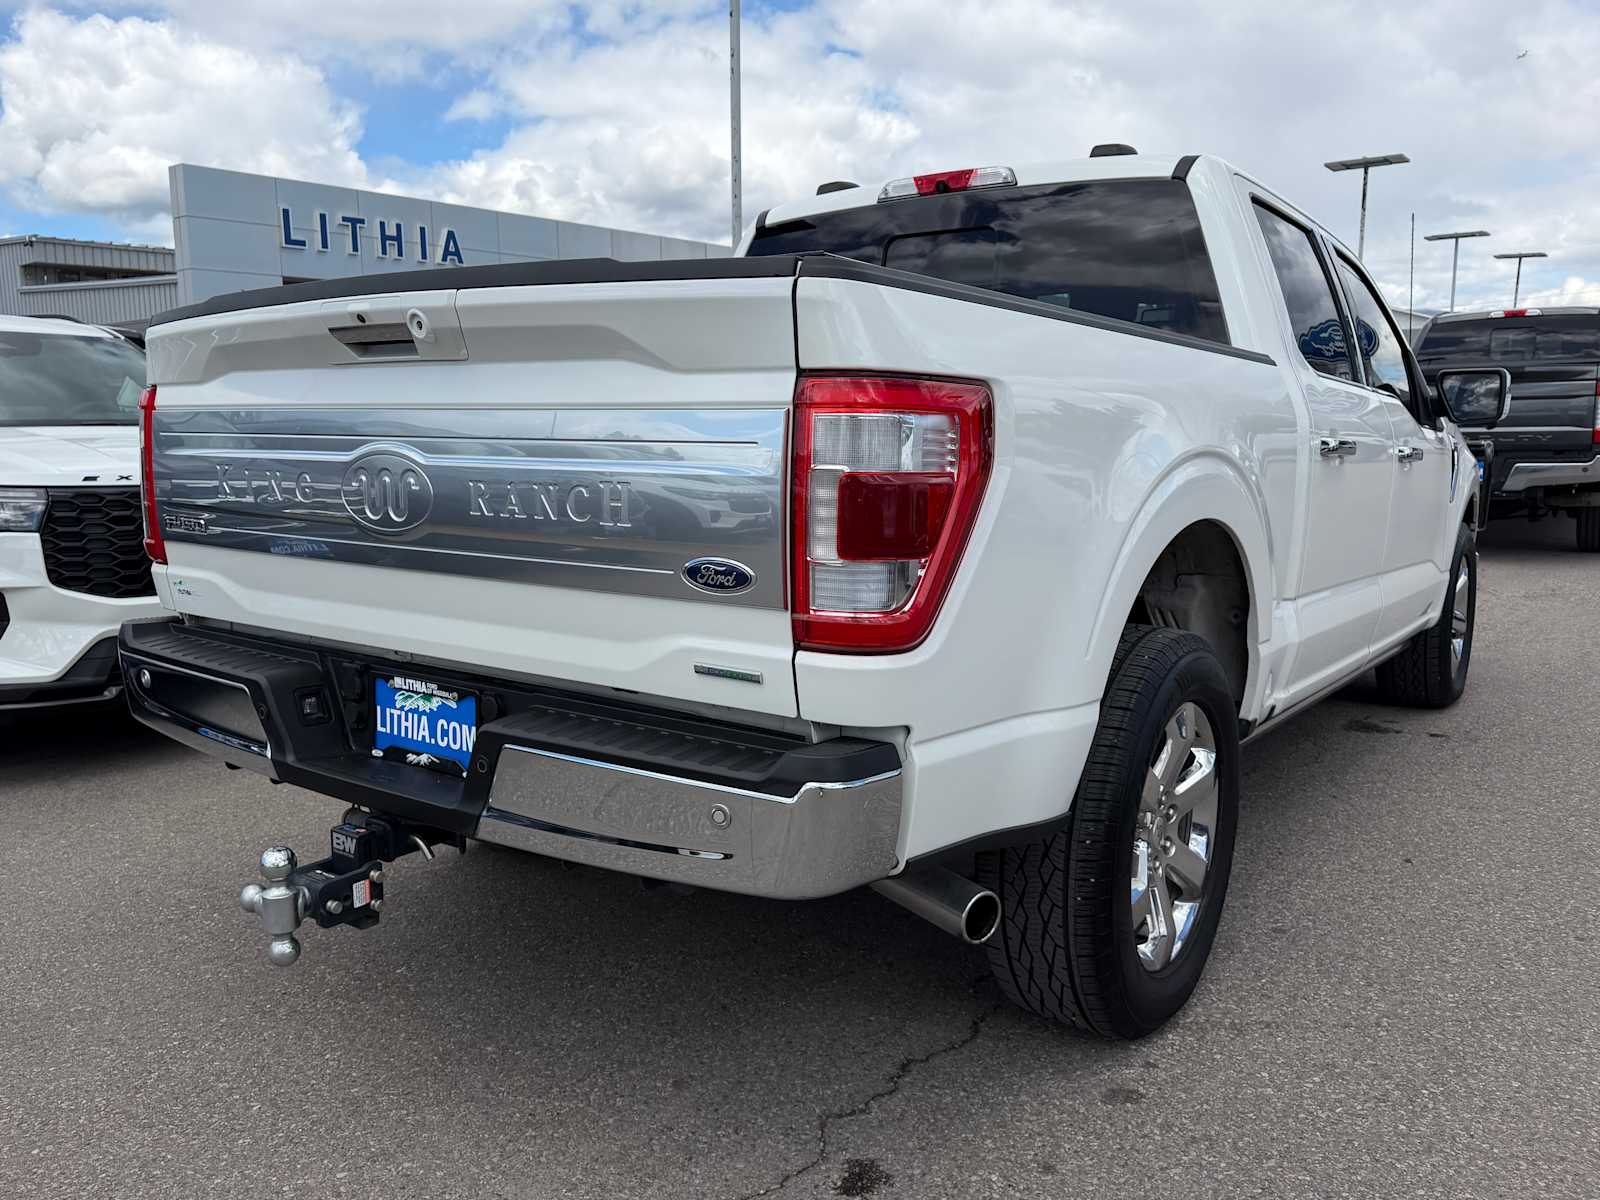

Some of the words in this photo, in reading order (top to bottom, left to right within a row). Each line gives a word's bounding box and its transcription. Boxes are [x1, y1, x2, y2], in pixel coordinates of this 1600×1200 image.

[280, 207, 465, 266] LITHIA
[216, 463, 313, 503] KING
[469, 479, 632, 527] RANCH
[696, 564, 737, 587] Ford
[402, 677, 427, 694] LITHIA
[376, 704, 477, 753] LITHIA.COM
